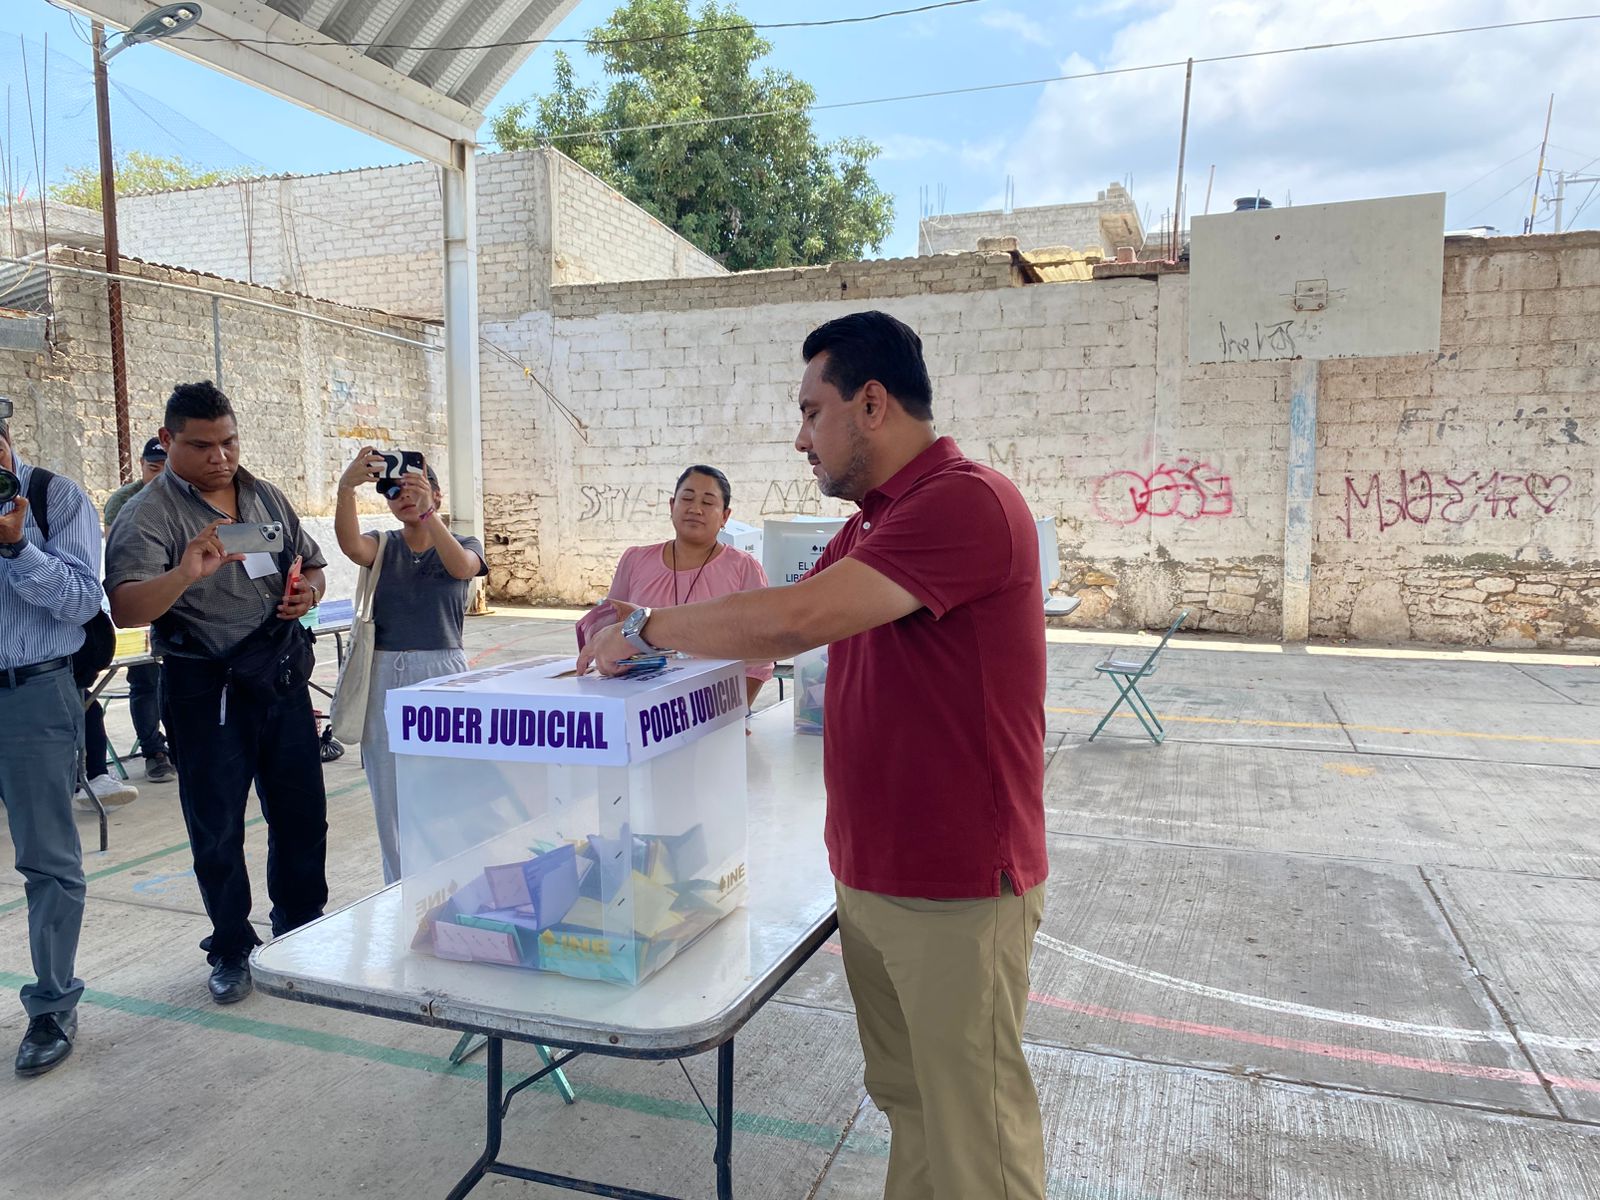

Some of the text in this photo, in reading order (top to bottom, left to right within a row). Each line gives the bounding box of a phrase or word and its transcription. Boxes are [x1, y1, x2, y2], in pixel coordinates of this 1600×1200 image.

[798, 561, 809, 571] EL
[640, 675, 743, 747] PODER JUDICIAL
[402, 705, 608, 749] PODER JUDICIAL
[727, 862, 746, 888] INE
[561, 934, 610, 955] INE
